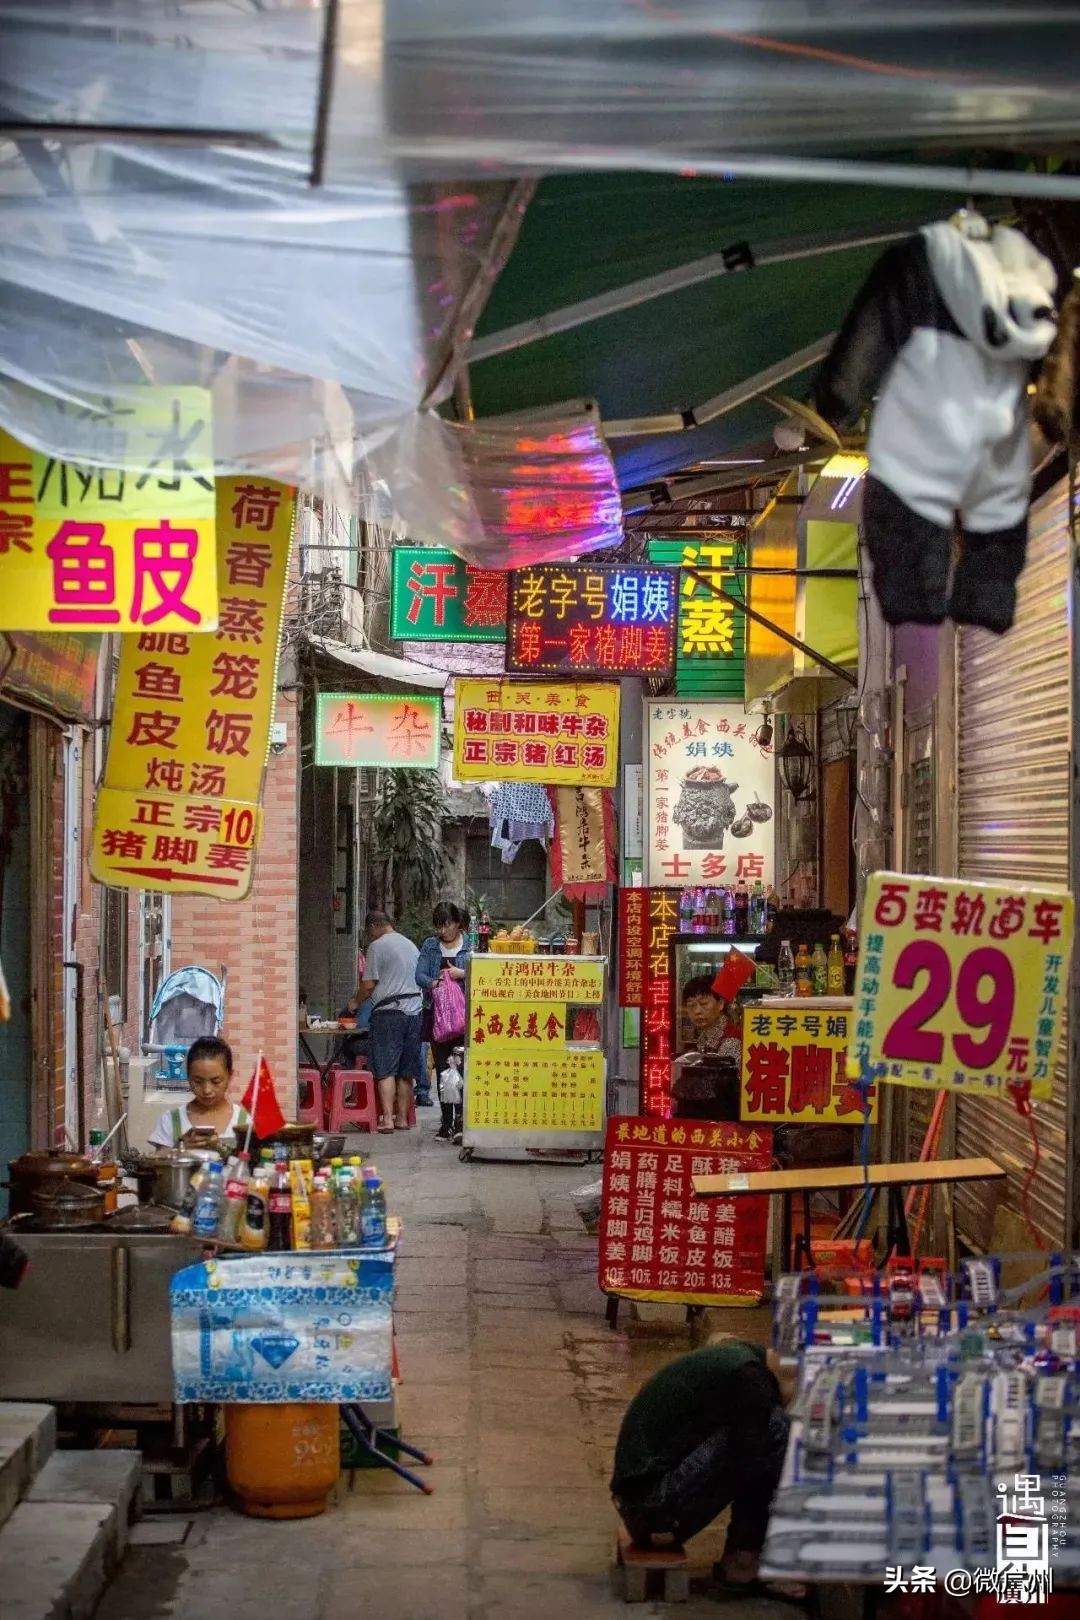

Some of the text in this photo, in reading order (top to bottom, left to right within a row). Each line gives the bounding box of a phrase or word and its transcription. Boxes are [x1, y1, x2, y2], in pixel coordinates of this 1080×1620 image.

[46, 519, 201, 625] 鱼皮
[406, 560, 508, 627] 汗蒸
[518, 573, 669, 622] 老字号娟姨
[682, 546, 734, 653] 汗蒸
[205, 484, 282, 757] 荷香蒸笼饭
[519, 621, 667, 666] 第一家猪脚姜
[325, 701, 432, 758] 牛杂
[465, 709, 607, 738] 秘制和味牛杂
[465, 740, 606, 768] 正宗猪红汤
[685, 742, 735, 758] 娟姨
[144, 756, 226, 797] 炖汤
[130, 799, 222, 834] 正宗
[655, 768, 670, 851] 第一家猪脚姜
[101, 829, 250, 872] 猪脚姜
[661, 853, 764, 879] 士多店
[874, 883, 1064, 945] 百变轨道车
[501, 961, 576, 977] 吉鸿居牛杂
[856, 934, 884, 1058] 提高动手能力
[1033, 954, 1062, 1078] 开发儿童智力
[487, 1012, 564, 1042] 西关美食
[751, 1014, 848, 1038] 老字号娟
[616, 1123, 763, 1150] 最地道的西关小食
[605, 1151, 632, 1262] 娟姨猪脚姜
[631, 1152, 658, 1263] 药膳当归鸡脚
[659, 1154, 684, 1265] 足料糯米饭
[686, 1156, 713, 1267] 酥脆鱼皮
[712, 1157, 741, 1268] 猪姜醋饭
[631, 1268, 651, 1283] 10元
[657, 1270, 678, 1286] 12元
[683, 1272, 706, 1288] 20元
[711, 1273, 732, 1288] 13元
